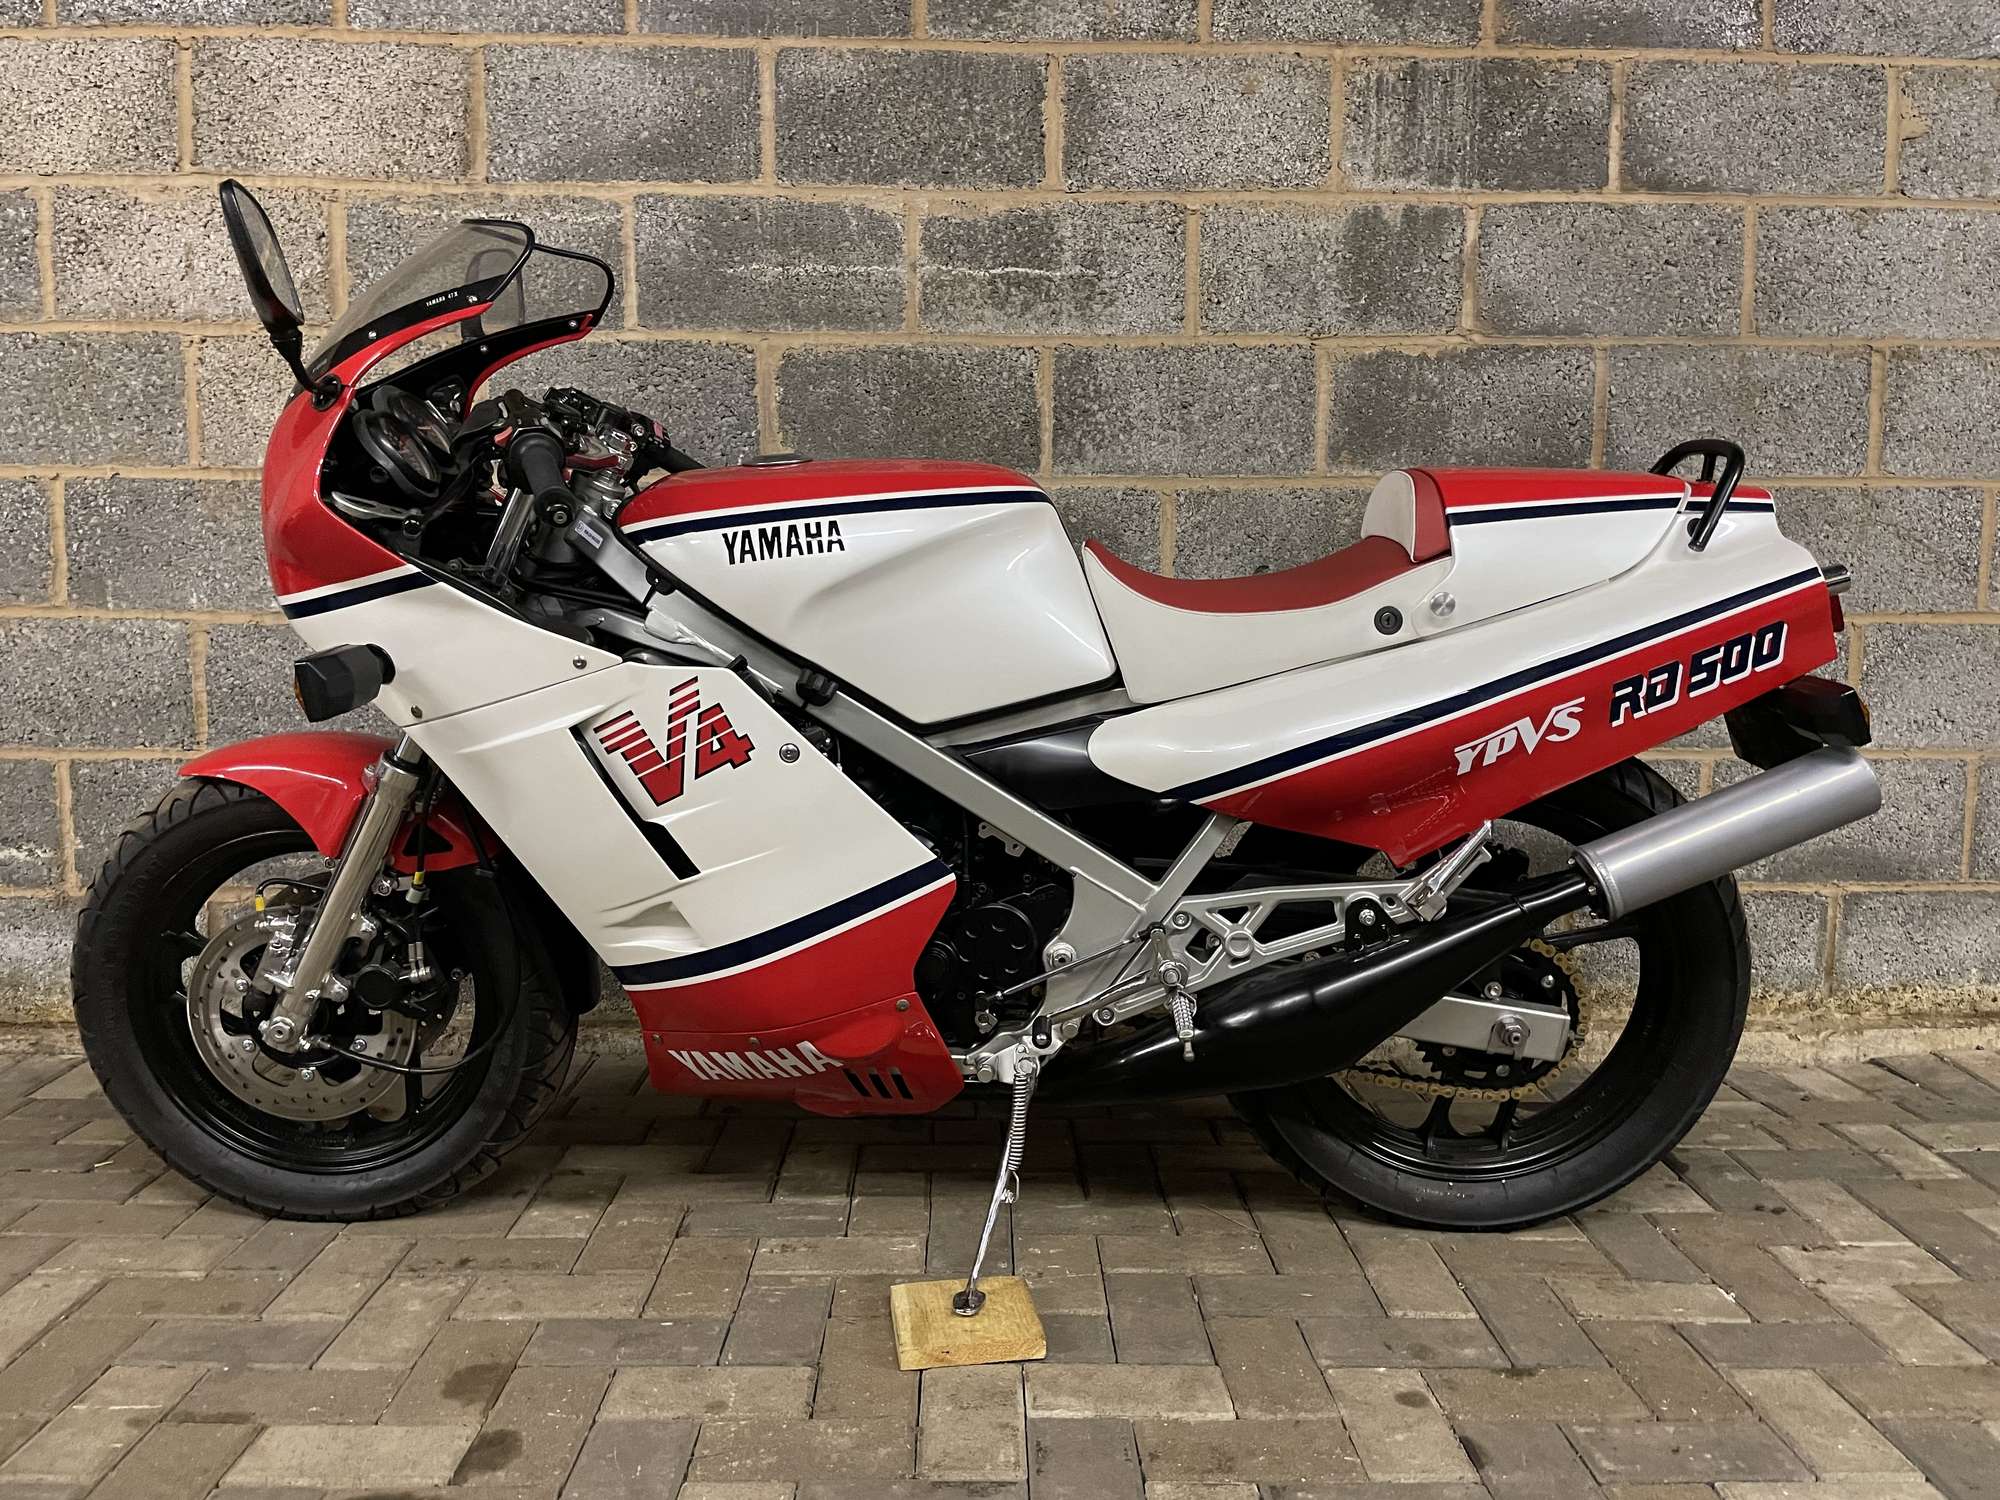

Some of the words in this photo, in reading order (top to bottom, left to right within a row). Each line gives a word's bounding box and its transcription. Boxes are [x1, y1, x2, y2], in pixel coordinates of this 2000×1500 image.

[721, 520, 845, 565] YAMAHA
[592, 675, 756, 807] V4
[1454, 696, 1586, 776] YPVS
[1609, 660, 1684, 728] RD
[1687, 620, 1788, 699] 500
[667, 1040, 844, 1081] YAMAHA
